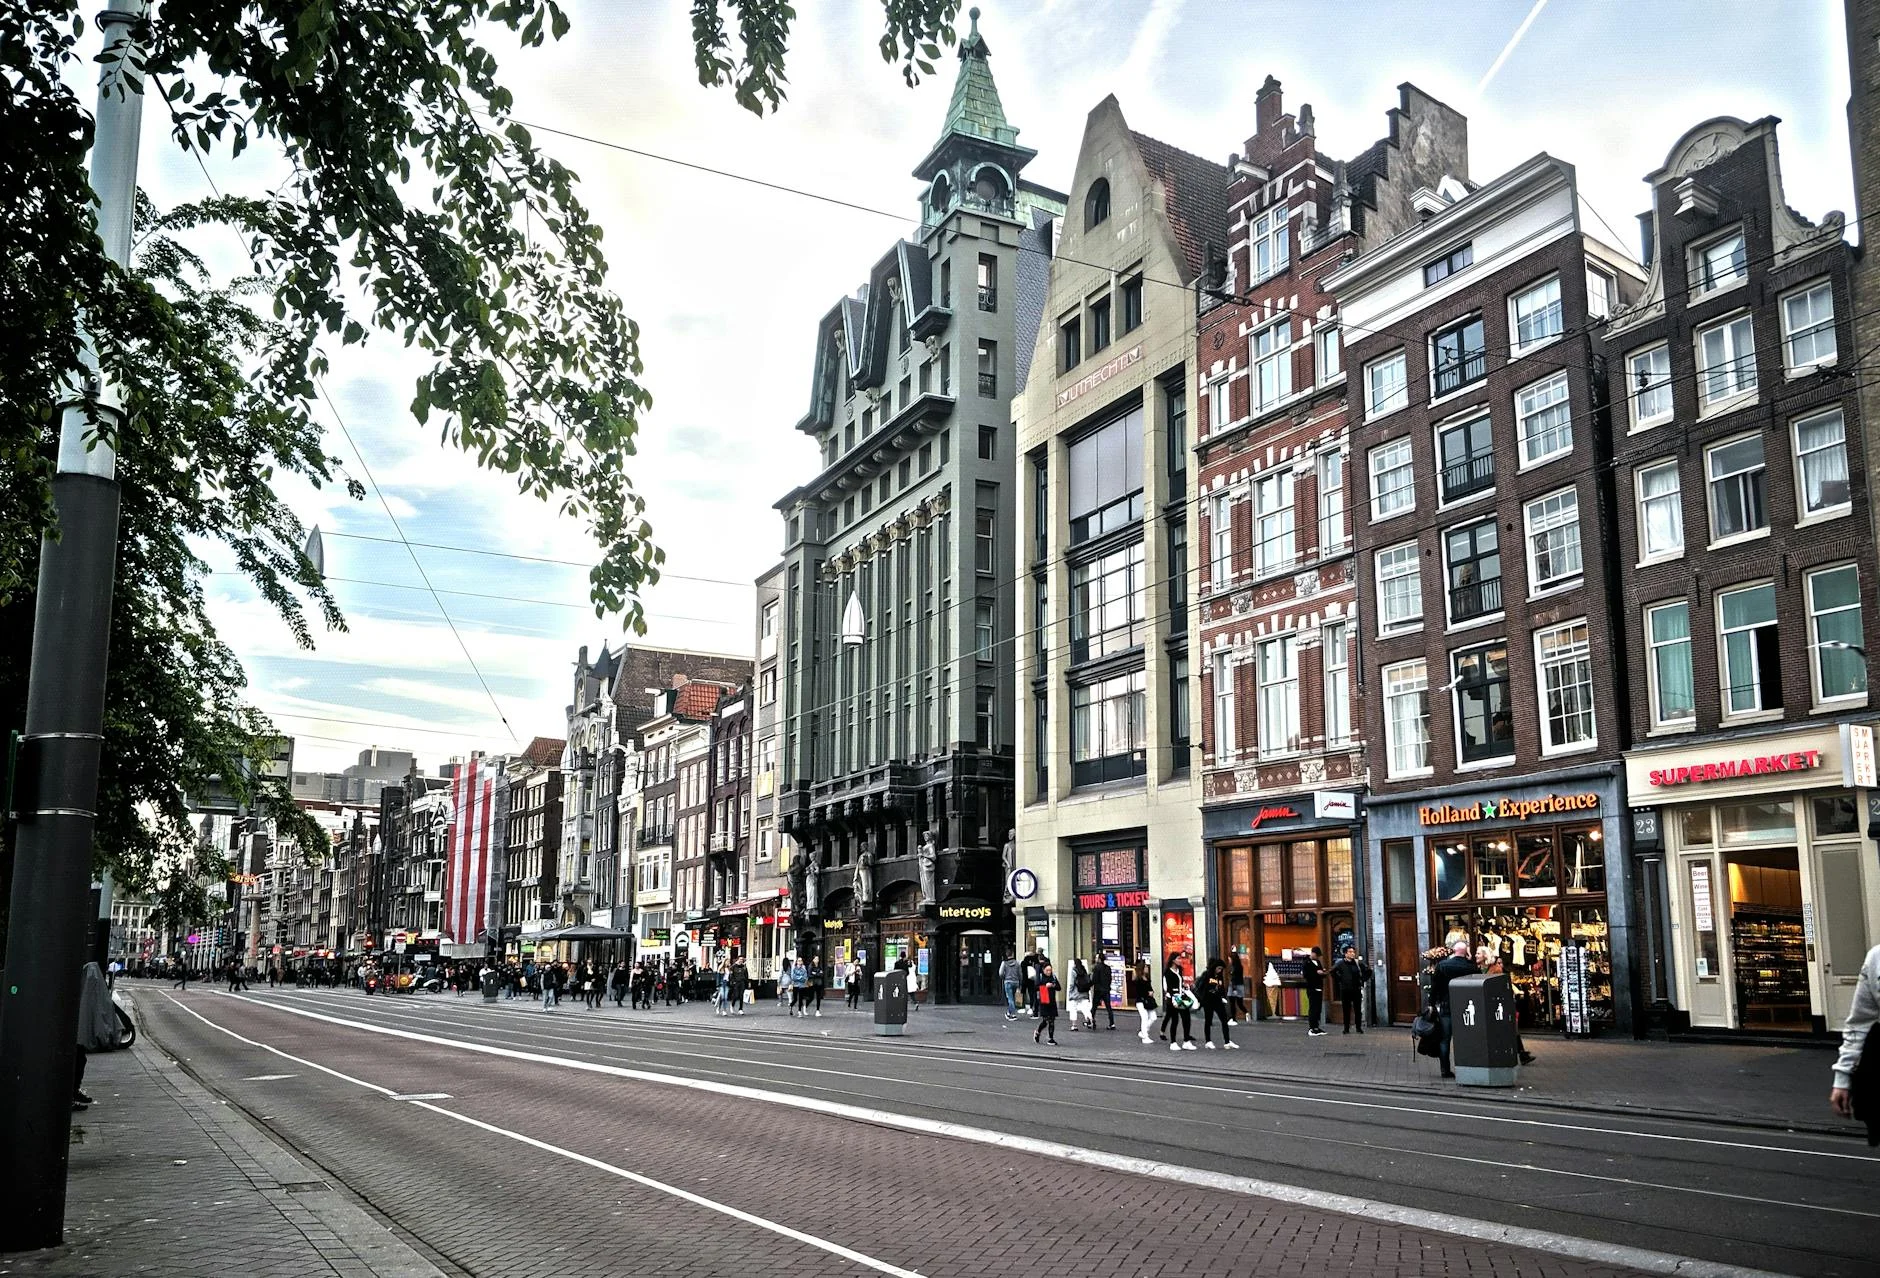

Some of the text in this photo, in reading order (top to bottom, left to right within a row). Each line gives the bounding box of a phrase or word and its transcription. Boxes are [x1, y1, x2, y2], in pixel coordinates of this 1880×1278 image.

[1650, 750, 1818, 786] SUPERMARKET
[1419, 793, 1597, 825] Holland Experience
[1635, 818, 1656, 834] 23
[1079, 893, 1106, 909] TOURS
[1107, 892, 1116, 908] &
